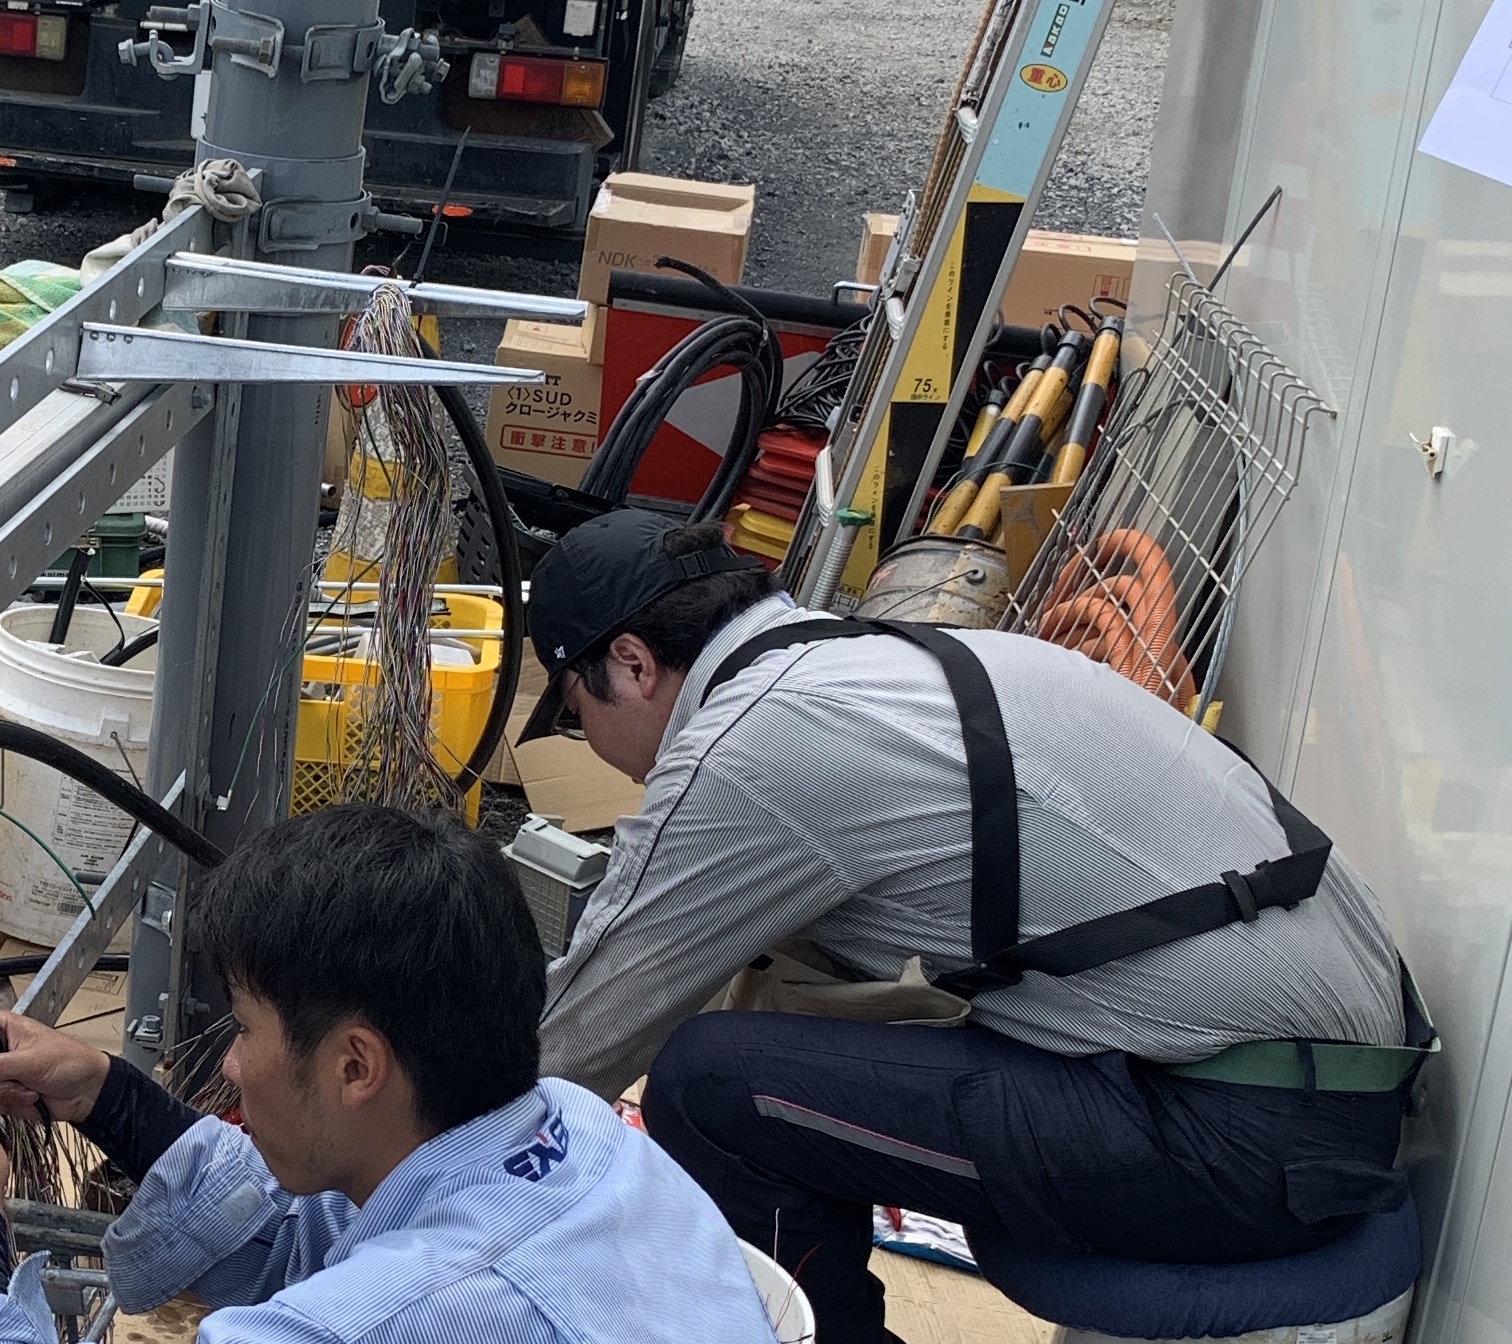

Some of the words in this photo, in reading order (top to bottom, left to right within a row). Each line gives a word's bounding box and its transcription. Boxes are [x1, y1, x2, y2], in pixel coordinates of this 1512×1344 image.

[1028, 66, 1062, 89] 重心
[597, 250, 638, 268] NDK
[913, 378, 933, 393] 75
